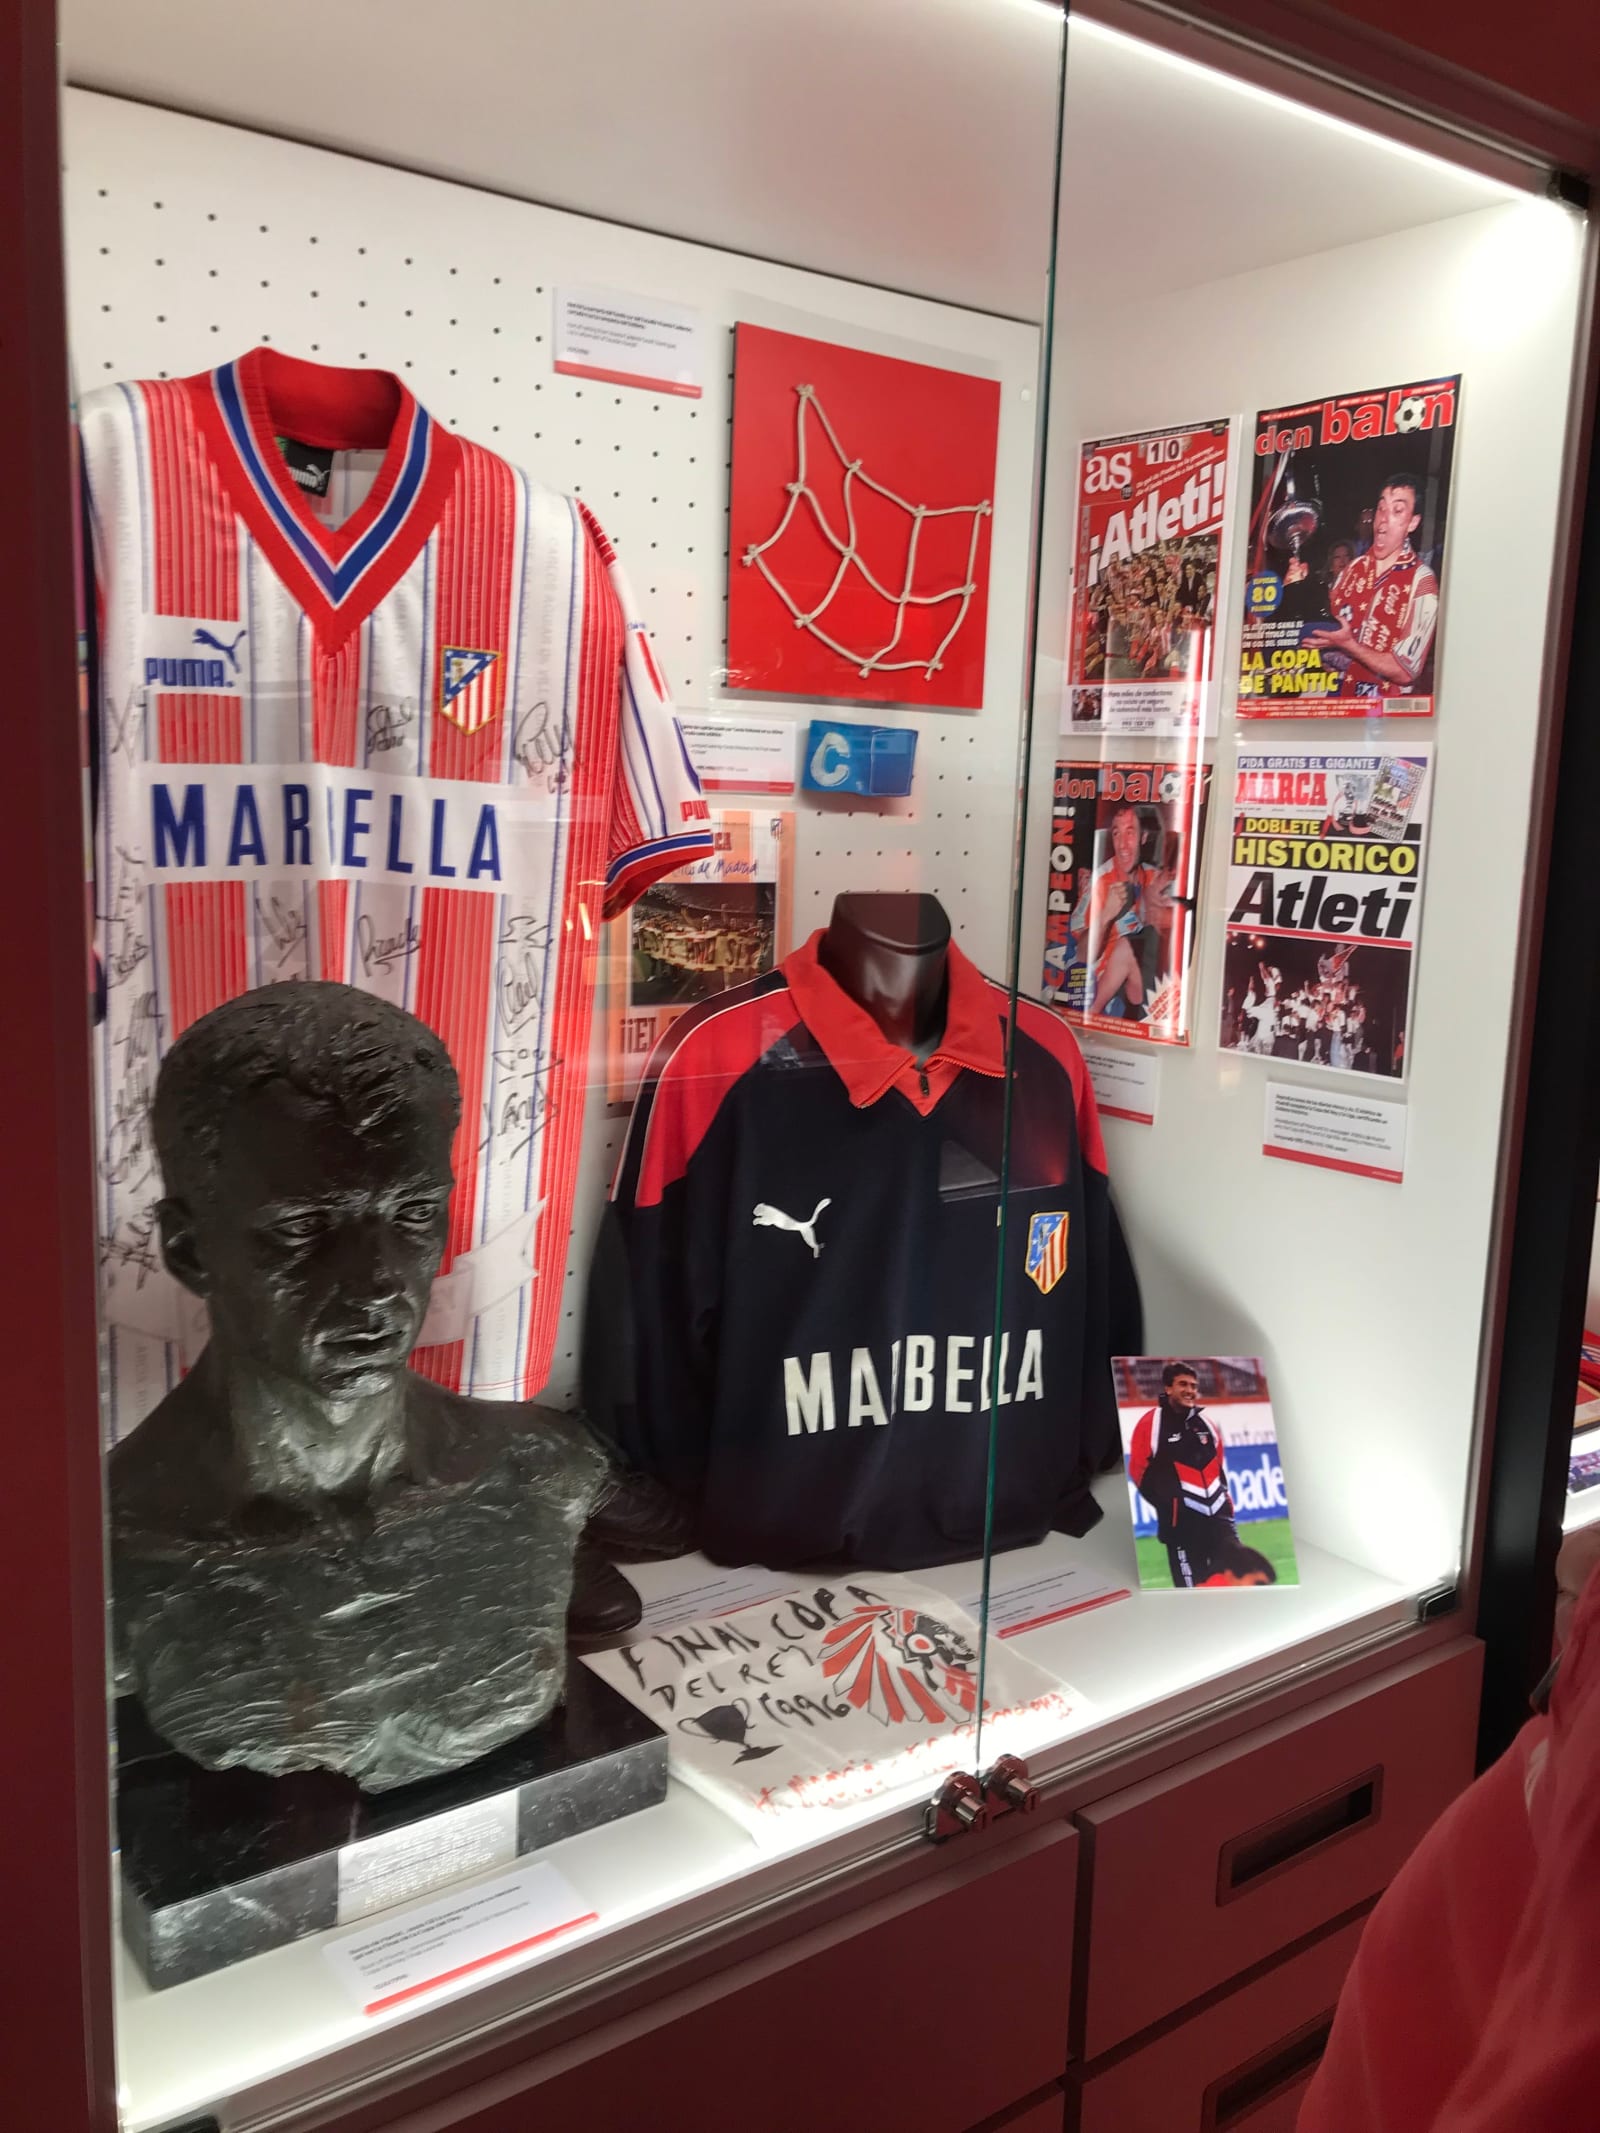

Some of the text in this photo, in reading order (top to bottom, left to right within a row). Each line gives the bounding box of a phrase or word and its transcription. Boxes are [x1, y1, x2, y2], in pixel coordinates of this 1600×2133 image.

[1084, 451, 1132, 494] as
[1252, 585, 1278, 602] 80
[145, 658, 224, 687] PUMA
[1241, 648, 1323, 671] LA COPA
[1271, 671, 1339, 694] PANTIC
[810, 732, 851, 787] C
[1239, 757, 1377, 769] PIDA GRATIS EL GIGANTE
[1054, 773, 1096, 800] don
[1235, 772, 1328, 806] MARCA
[152, 784, 503, 881] MARELLA
[1235, 838, 1416, 875] HISTORICO
[1227, 872, 1418, 939] Atleti
[783, 1329, 1045, 1436] MABELLA
[618, 1621, 760, 1689] FINAL
[771, 1584, 889, 1640] COPA
[649, 1643, 818, 1711] DEL REY
